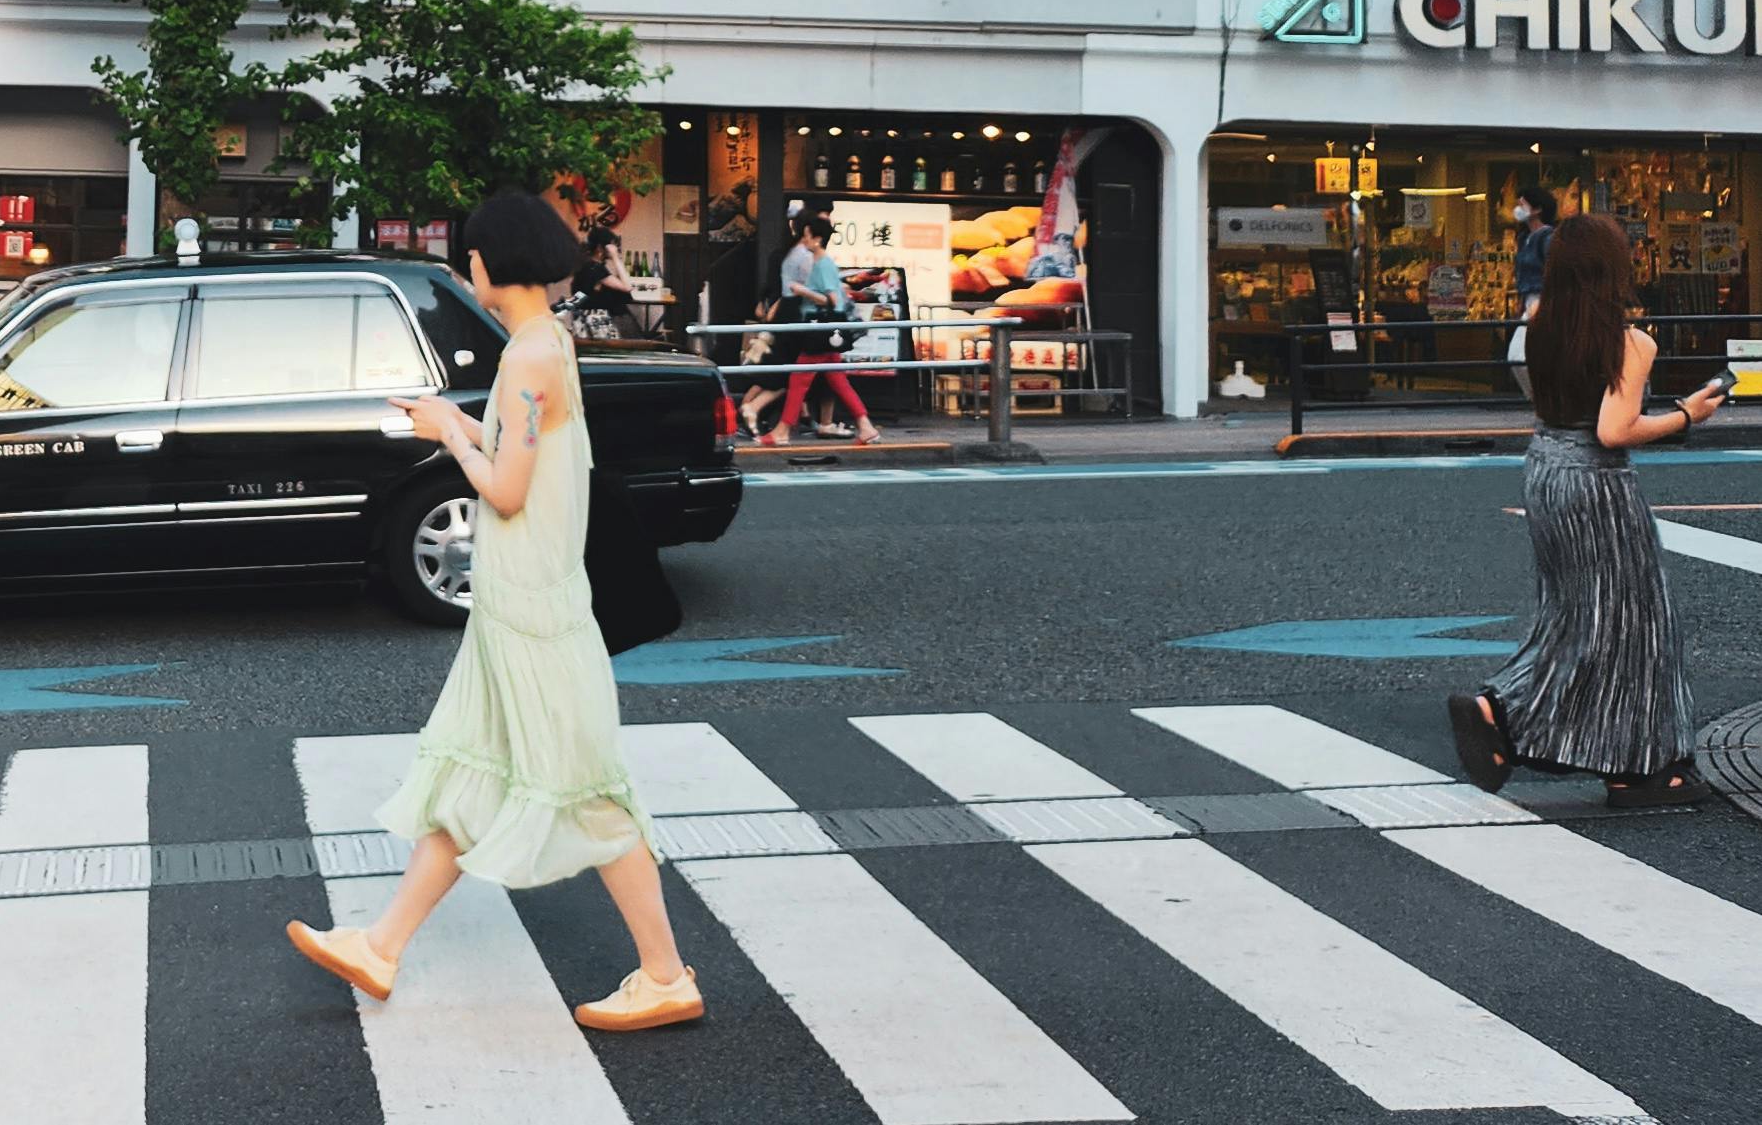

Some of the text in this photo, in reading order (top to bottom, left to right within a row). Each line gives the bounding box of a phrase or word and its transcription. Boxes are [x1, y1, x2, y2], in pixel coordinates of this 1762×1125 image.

[52, 441, 85, 454] CAB
[227, 480, 305, 495] TAXI 226
